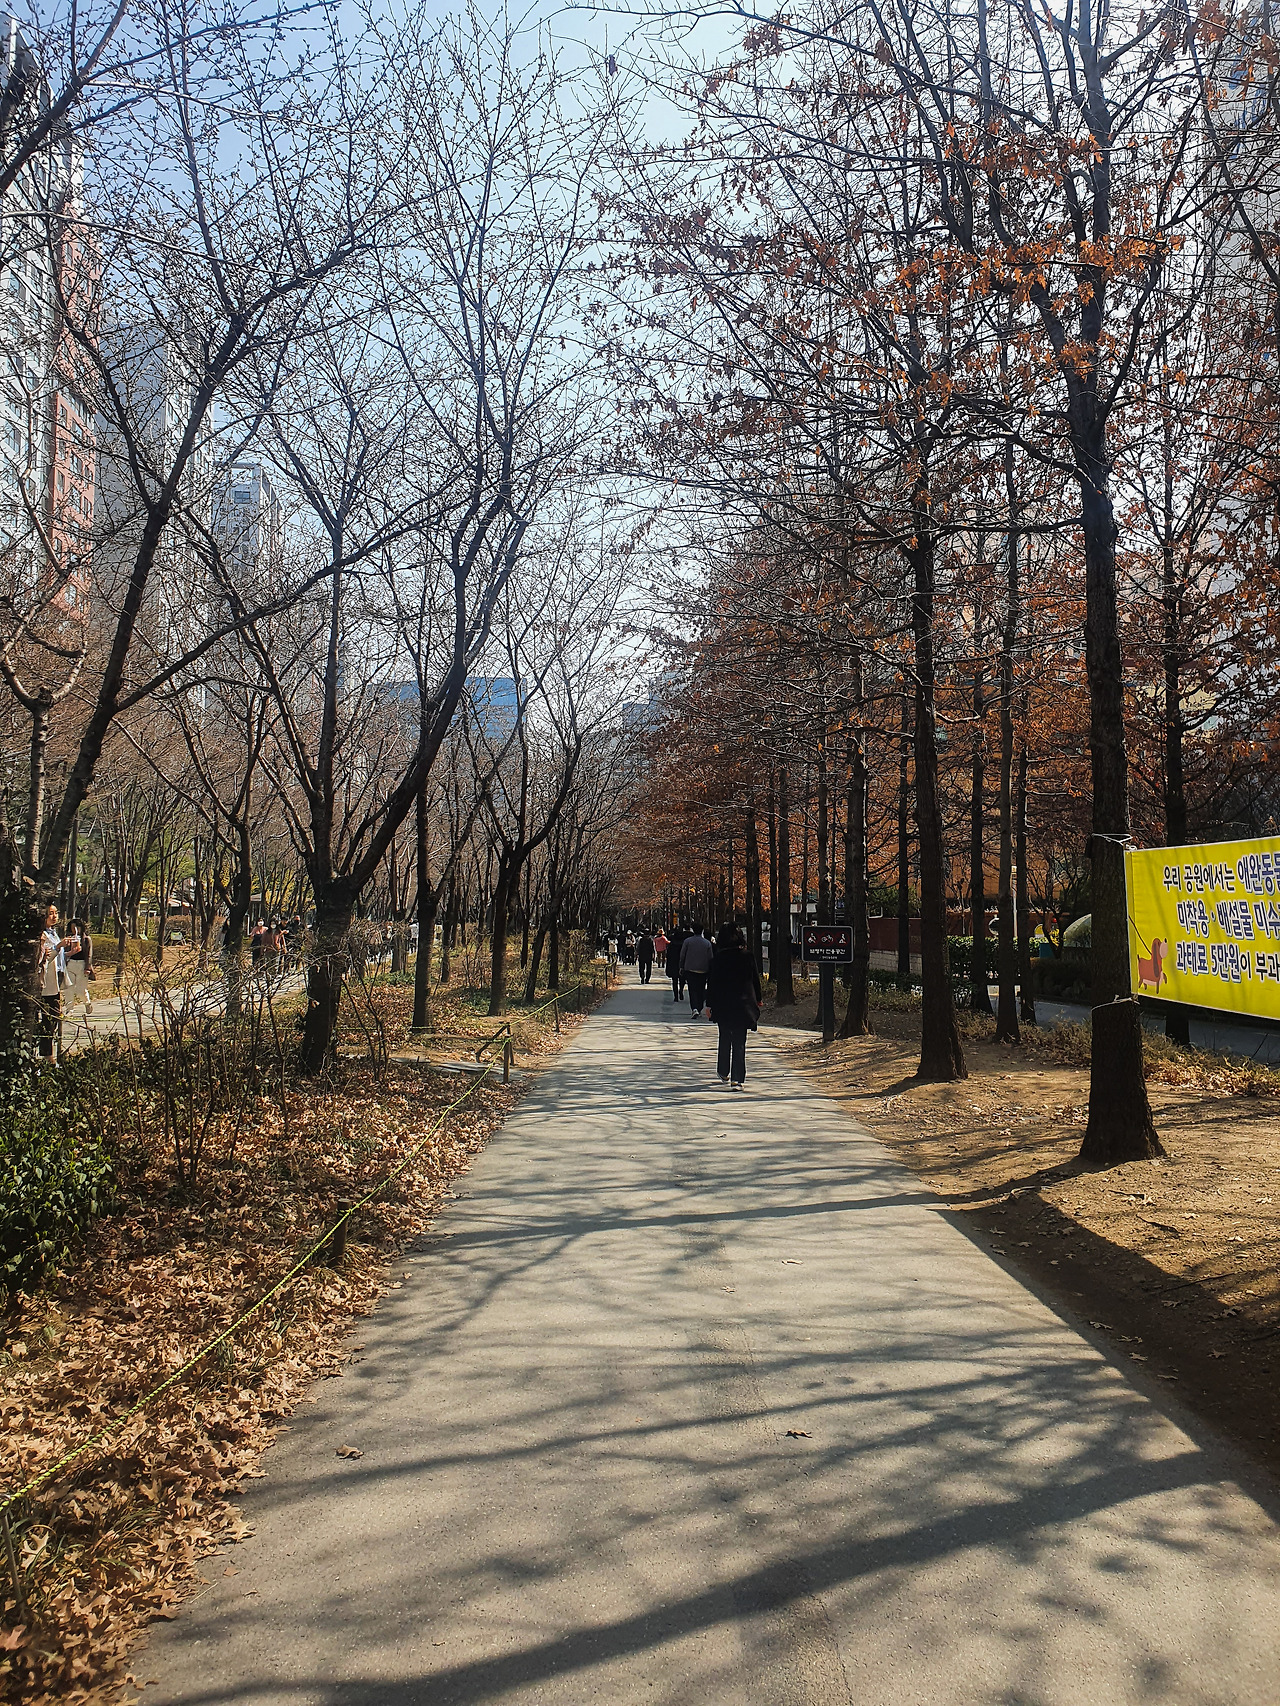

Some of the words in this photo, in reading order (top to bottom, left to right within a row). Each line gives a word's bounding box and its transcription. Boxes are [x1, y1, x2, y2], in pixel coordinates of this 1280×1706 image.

[1163, 865, 1182, 892] 우리
[1184, 863, 1236, 893] 공원에서는
[1177, 900, 1208, 936] 미착용
[1216, 901, 1253, 938] 배설물
[1253, 901, 1280, 938] 미수
[1176, 941, 1208, 973] 과태료
[1210, 943, 1252, 981] 5만원이
[1256, 951, 1280, 982] 부과
